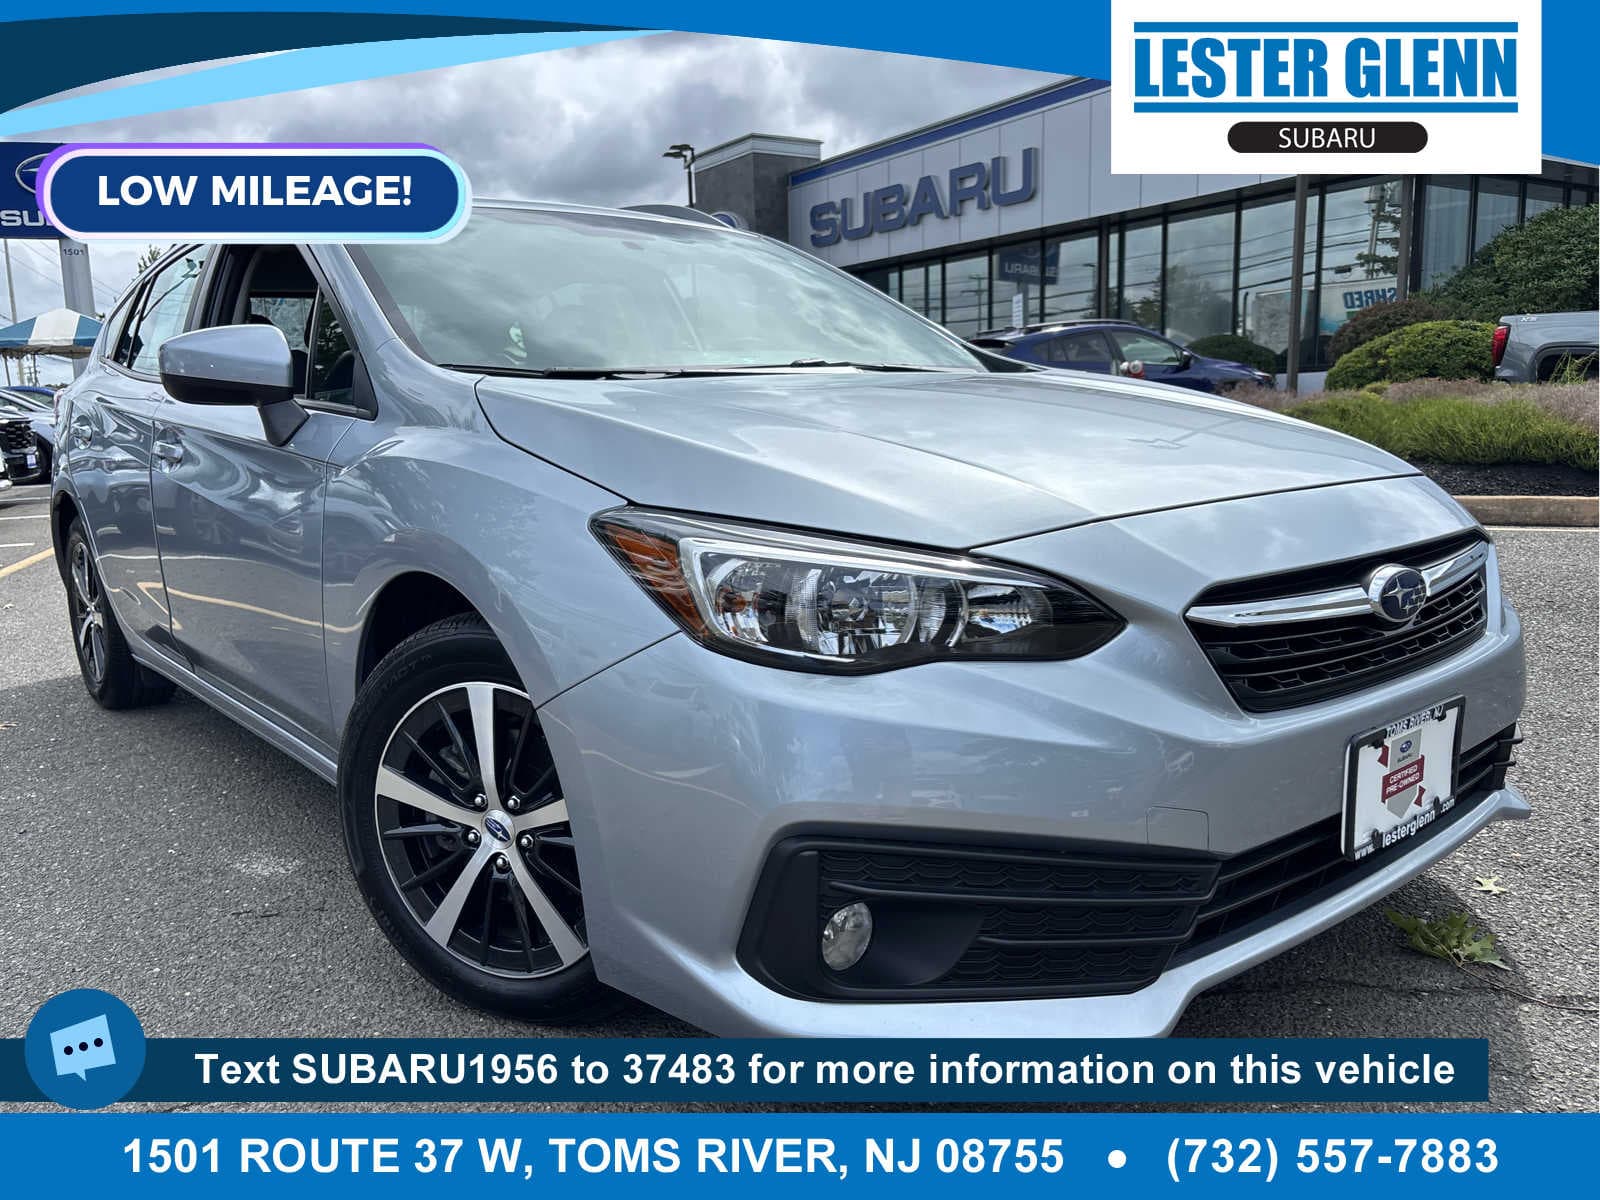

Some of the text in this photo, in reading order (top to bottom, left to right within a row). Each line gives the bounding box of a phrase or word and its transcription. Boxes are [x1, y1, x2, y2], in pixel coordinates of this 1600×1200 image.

[810, 148, 1038, 248] SUBARU
[1386, 772, 1420, 795] PRE-OWNED
[1389, 764, 1418, 784] CERTIFIED
